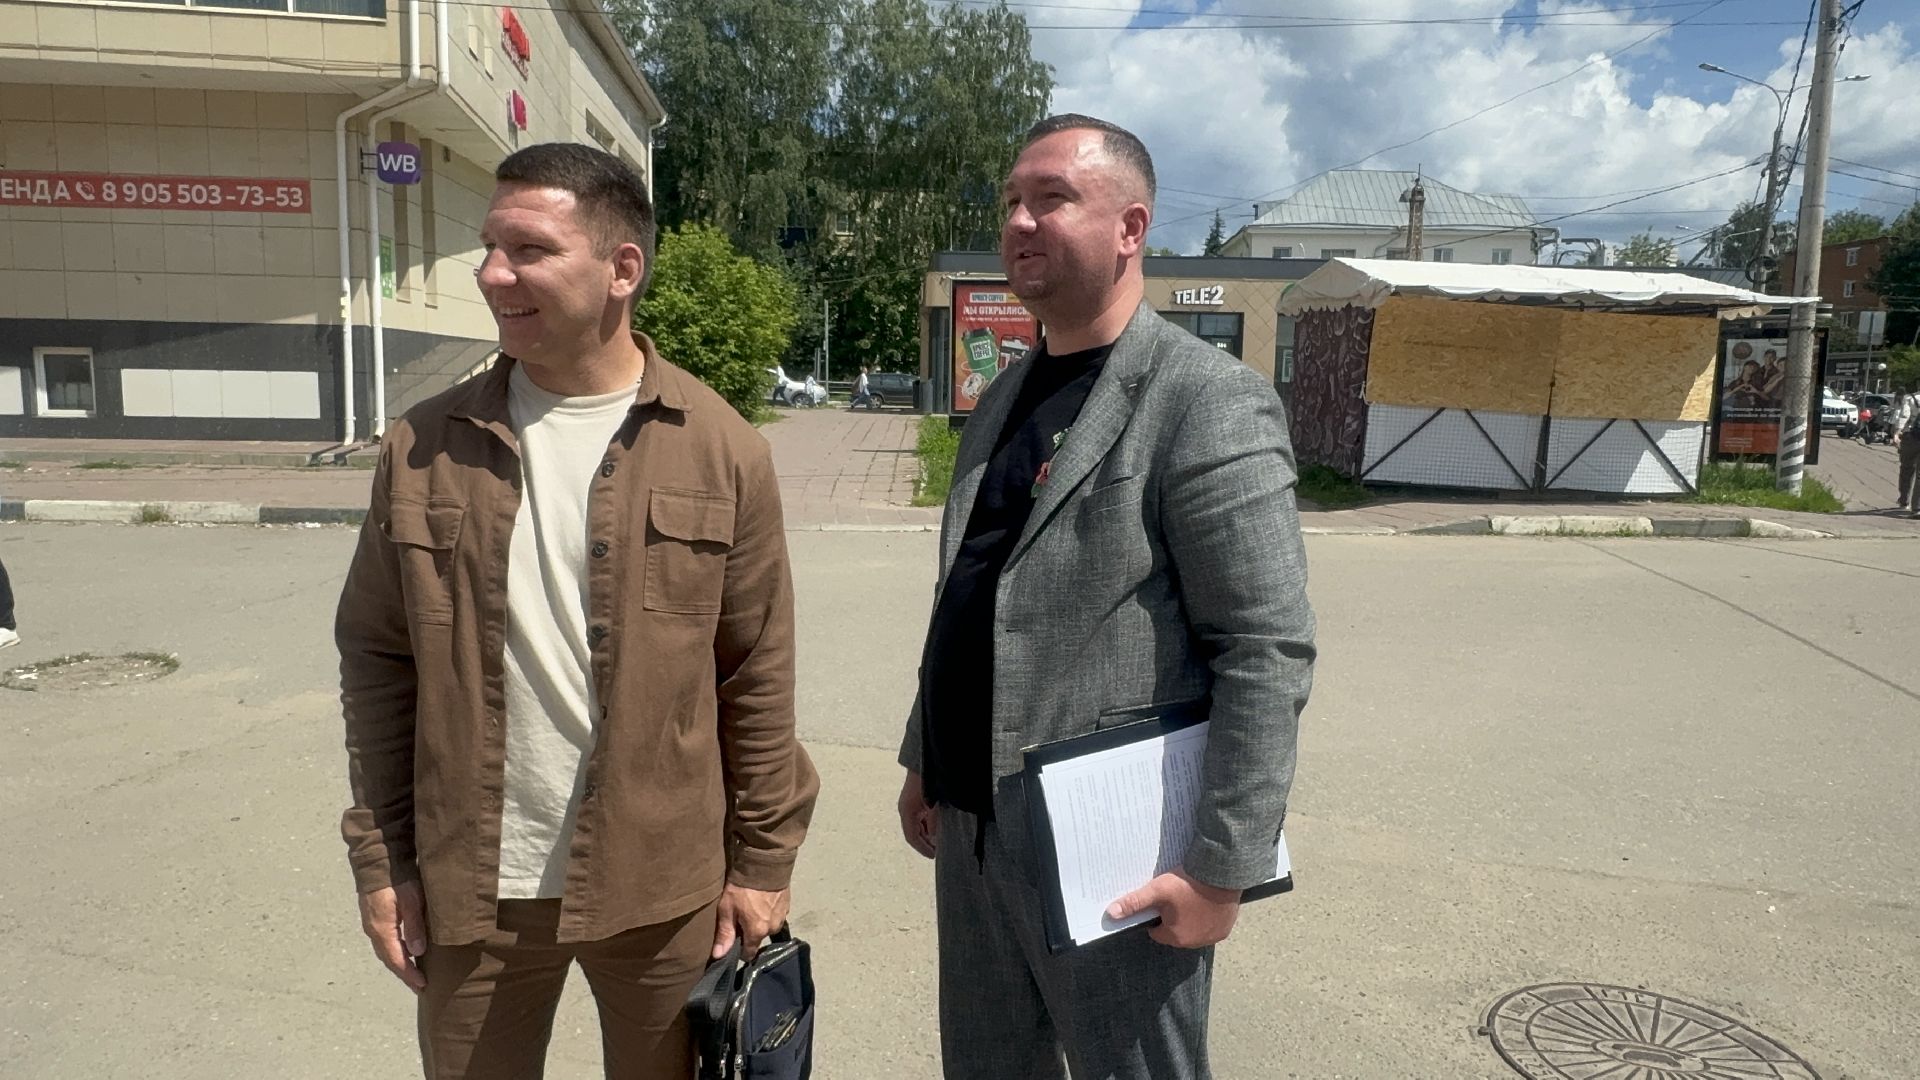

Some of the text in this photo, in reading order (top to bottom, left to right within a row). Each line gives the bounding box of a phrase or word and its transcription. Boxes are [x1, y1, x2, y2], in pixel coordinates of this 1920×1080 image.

[379, 153, 416, 173] WB
[1, 179, 71, 203] ЕНДА
[1174, 285, 1224, 305] TELE2
[963, 306, 977, 315] МЫ
